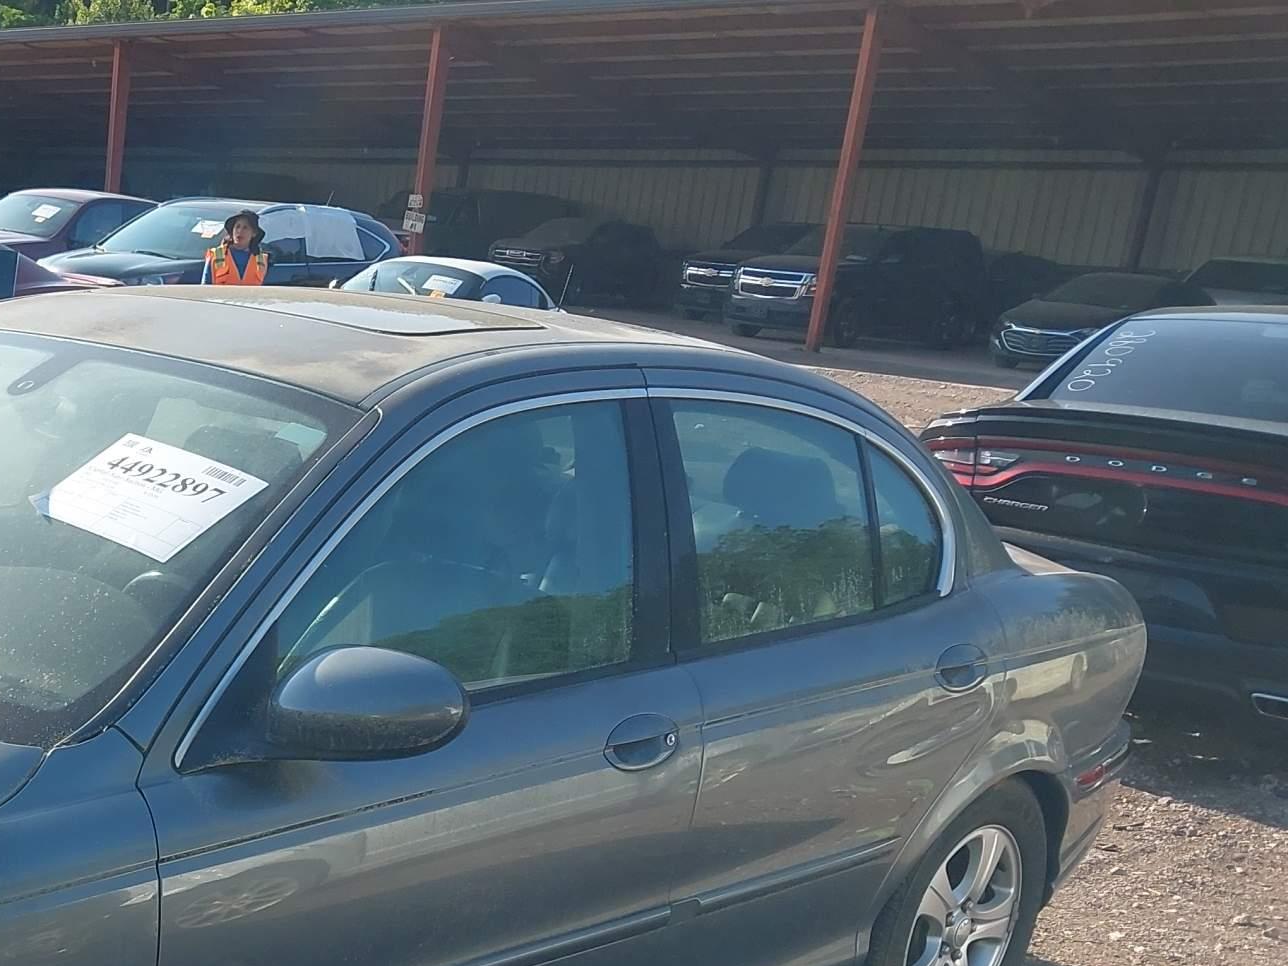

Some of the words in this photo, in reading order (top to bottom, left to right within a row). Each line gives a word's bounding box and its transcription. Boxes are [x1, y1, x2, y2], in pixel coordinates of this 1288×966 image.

[106, 455, 228, 504] 44922897
[1065, 454, 1258, 486] DODGE
[982, 495, 1050, 512] CHARGER
